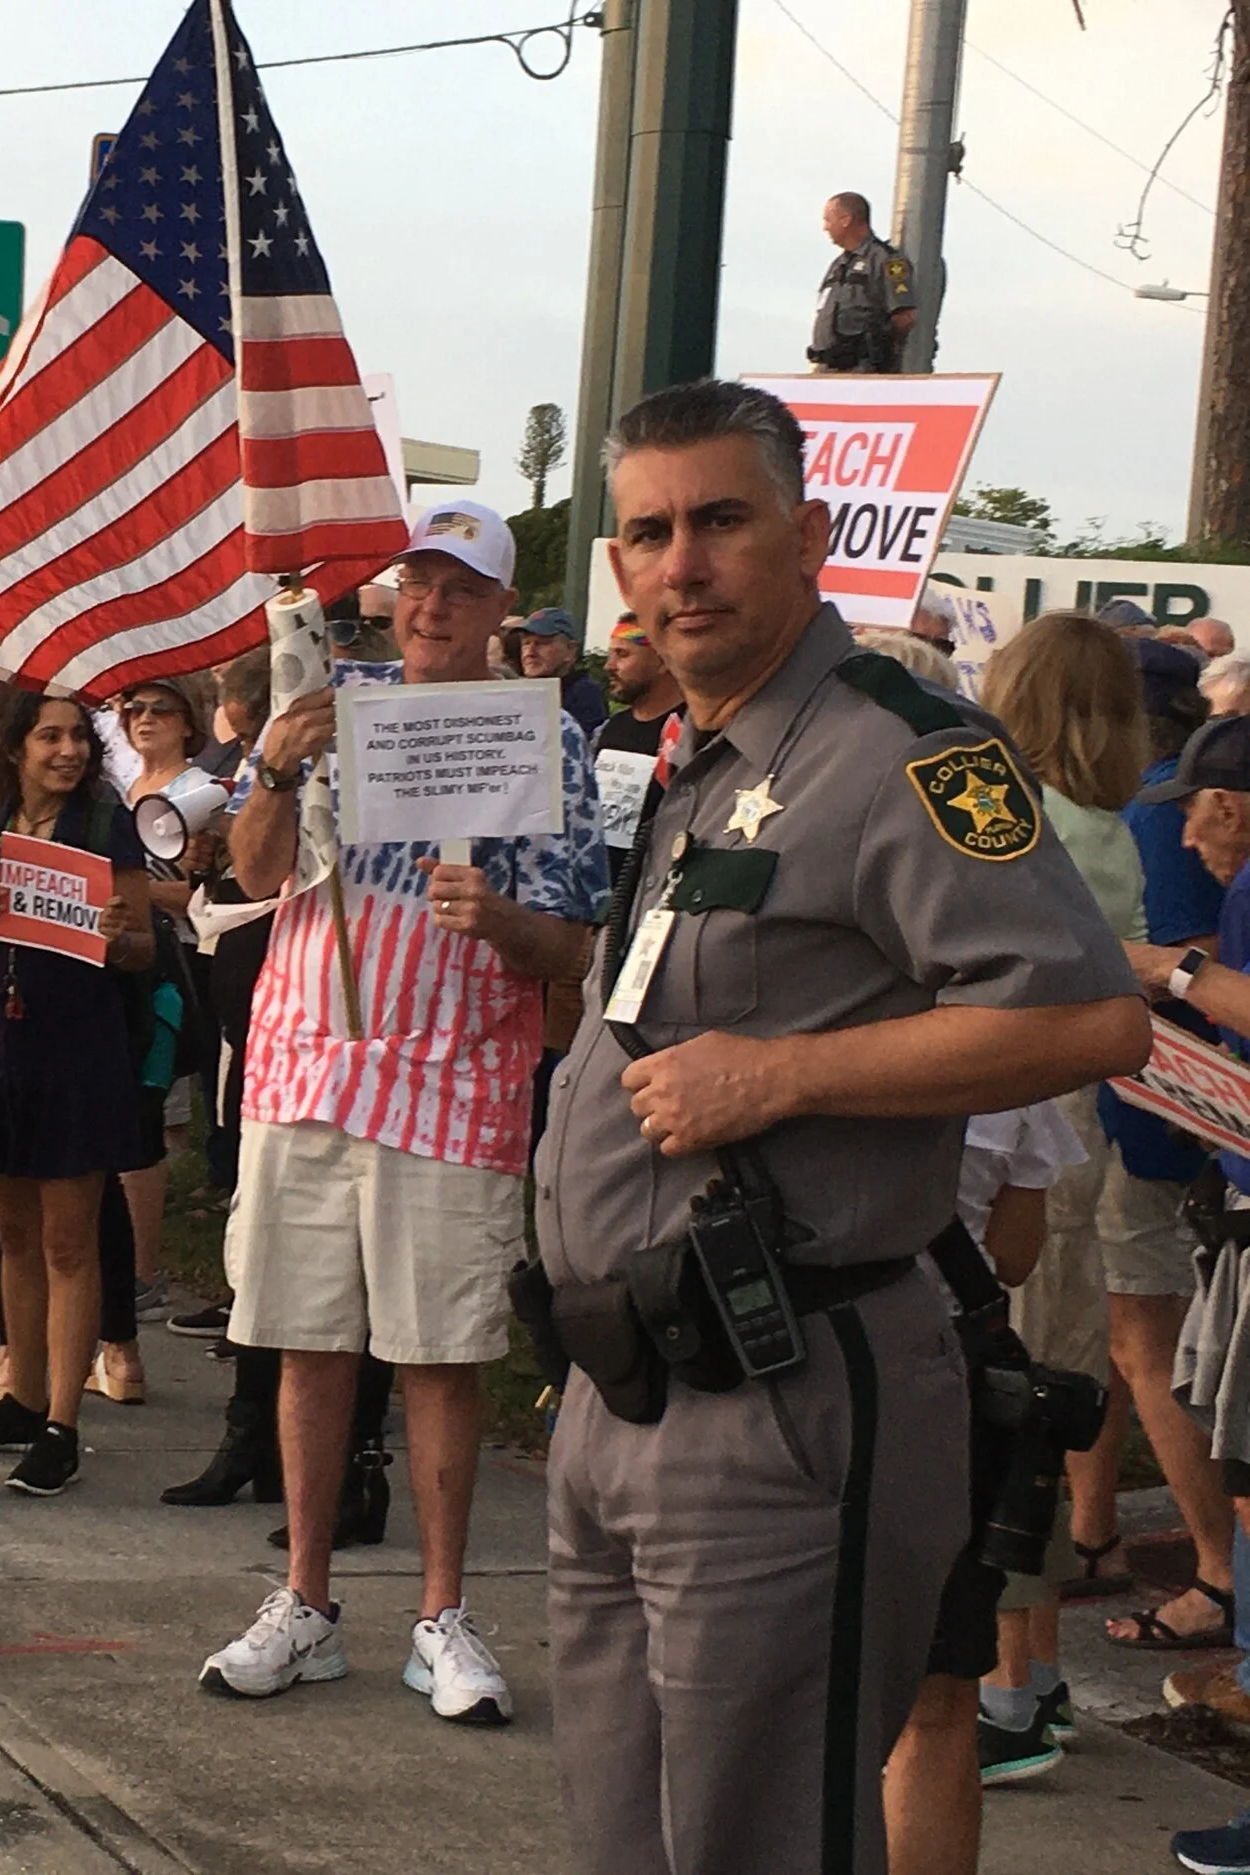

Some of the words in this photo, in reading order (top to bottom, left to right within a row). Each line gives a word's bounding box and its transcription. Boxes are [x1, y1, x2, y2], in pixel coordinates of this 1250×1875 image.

[373, 723, 400, 734] THE
[403, 718, 440, 731] MOST
[444, 714, 521, 729] DISHONEST
[366, 740, 395, 750] AND
[398, 734, 463, 749] CORRUPT
[467, 731, 536, 745] SCUMBAG
[406, 754, 421, 765] IN
[424, 752, 442, 763] US
[368, 767, 432, 783] PATRIOTS
[435, 766, 472, 779] MUST
[476, 764, 538, 777] IMPEACH
[929, 755, 1007, 794] COLLIER
[393, 788, 420, 799] THE
[424, 784, 465, 796] SLIMY
[964, 818, 1032, 849] COUNTY
[1, 861, 84, 902] IMPEACH
[13, 891, 28, 913] &
